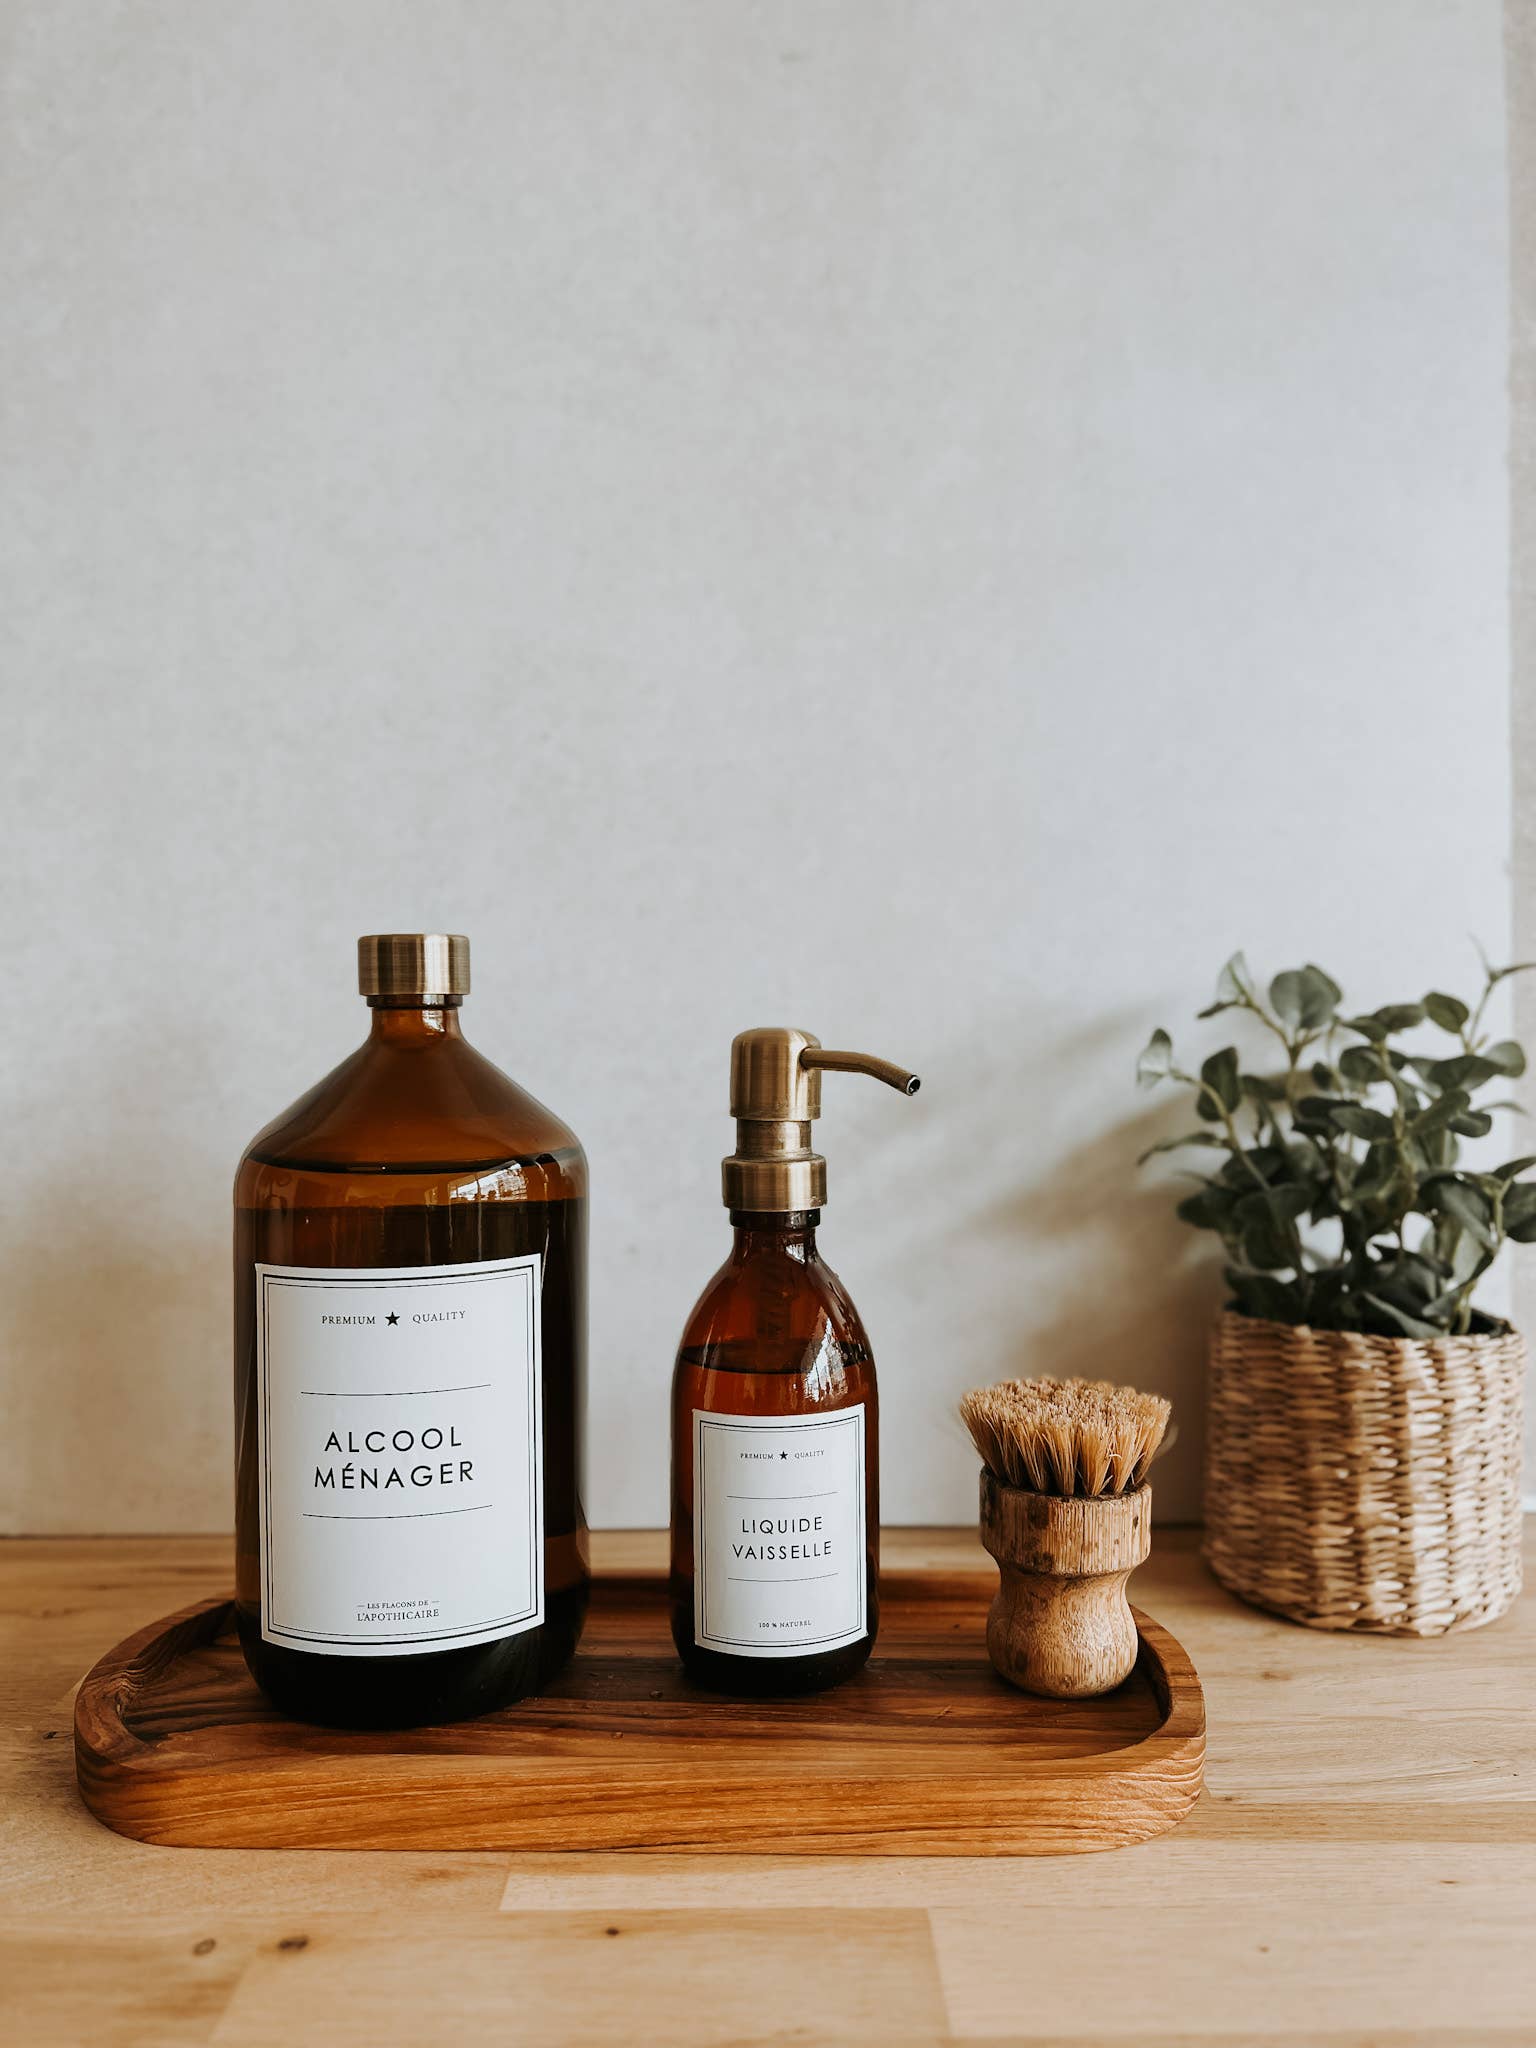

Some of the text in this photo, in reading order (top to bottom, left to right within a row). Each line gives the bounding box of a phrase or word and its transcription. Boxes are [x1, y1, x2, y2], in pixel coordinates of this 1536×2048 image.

[320, 1310, 466, 1326] PREMIUM QUALITY
[323, 1425, 463, 1454] ALCOOL
[739, 1449, 825, 1461] PREMIUM QUALITY
[313, 1460, 475, 1490] MÉNAGER
[741, 1516, 822, 1535] LIQUIDE
[731, 1540, 833, 1561] VAISSELLE
[381, 1600, 416, 1609] FLACONS
[779, 1619, 812, 1629] NATUREL
